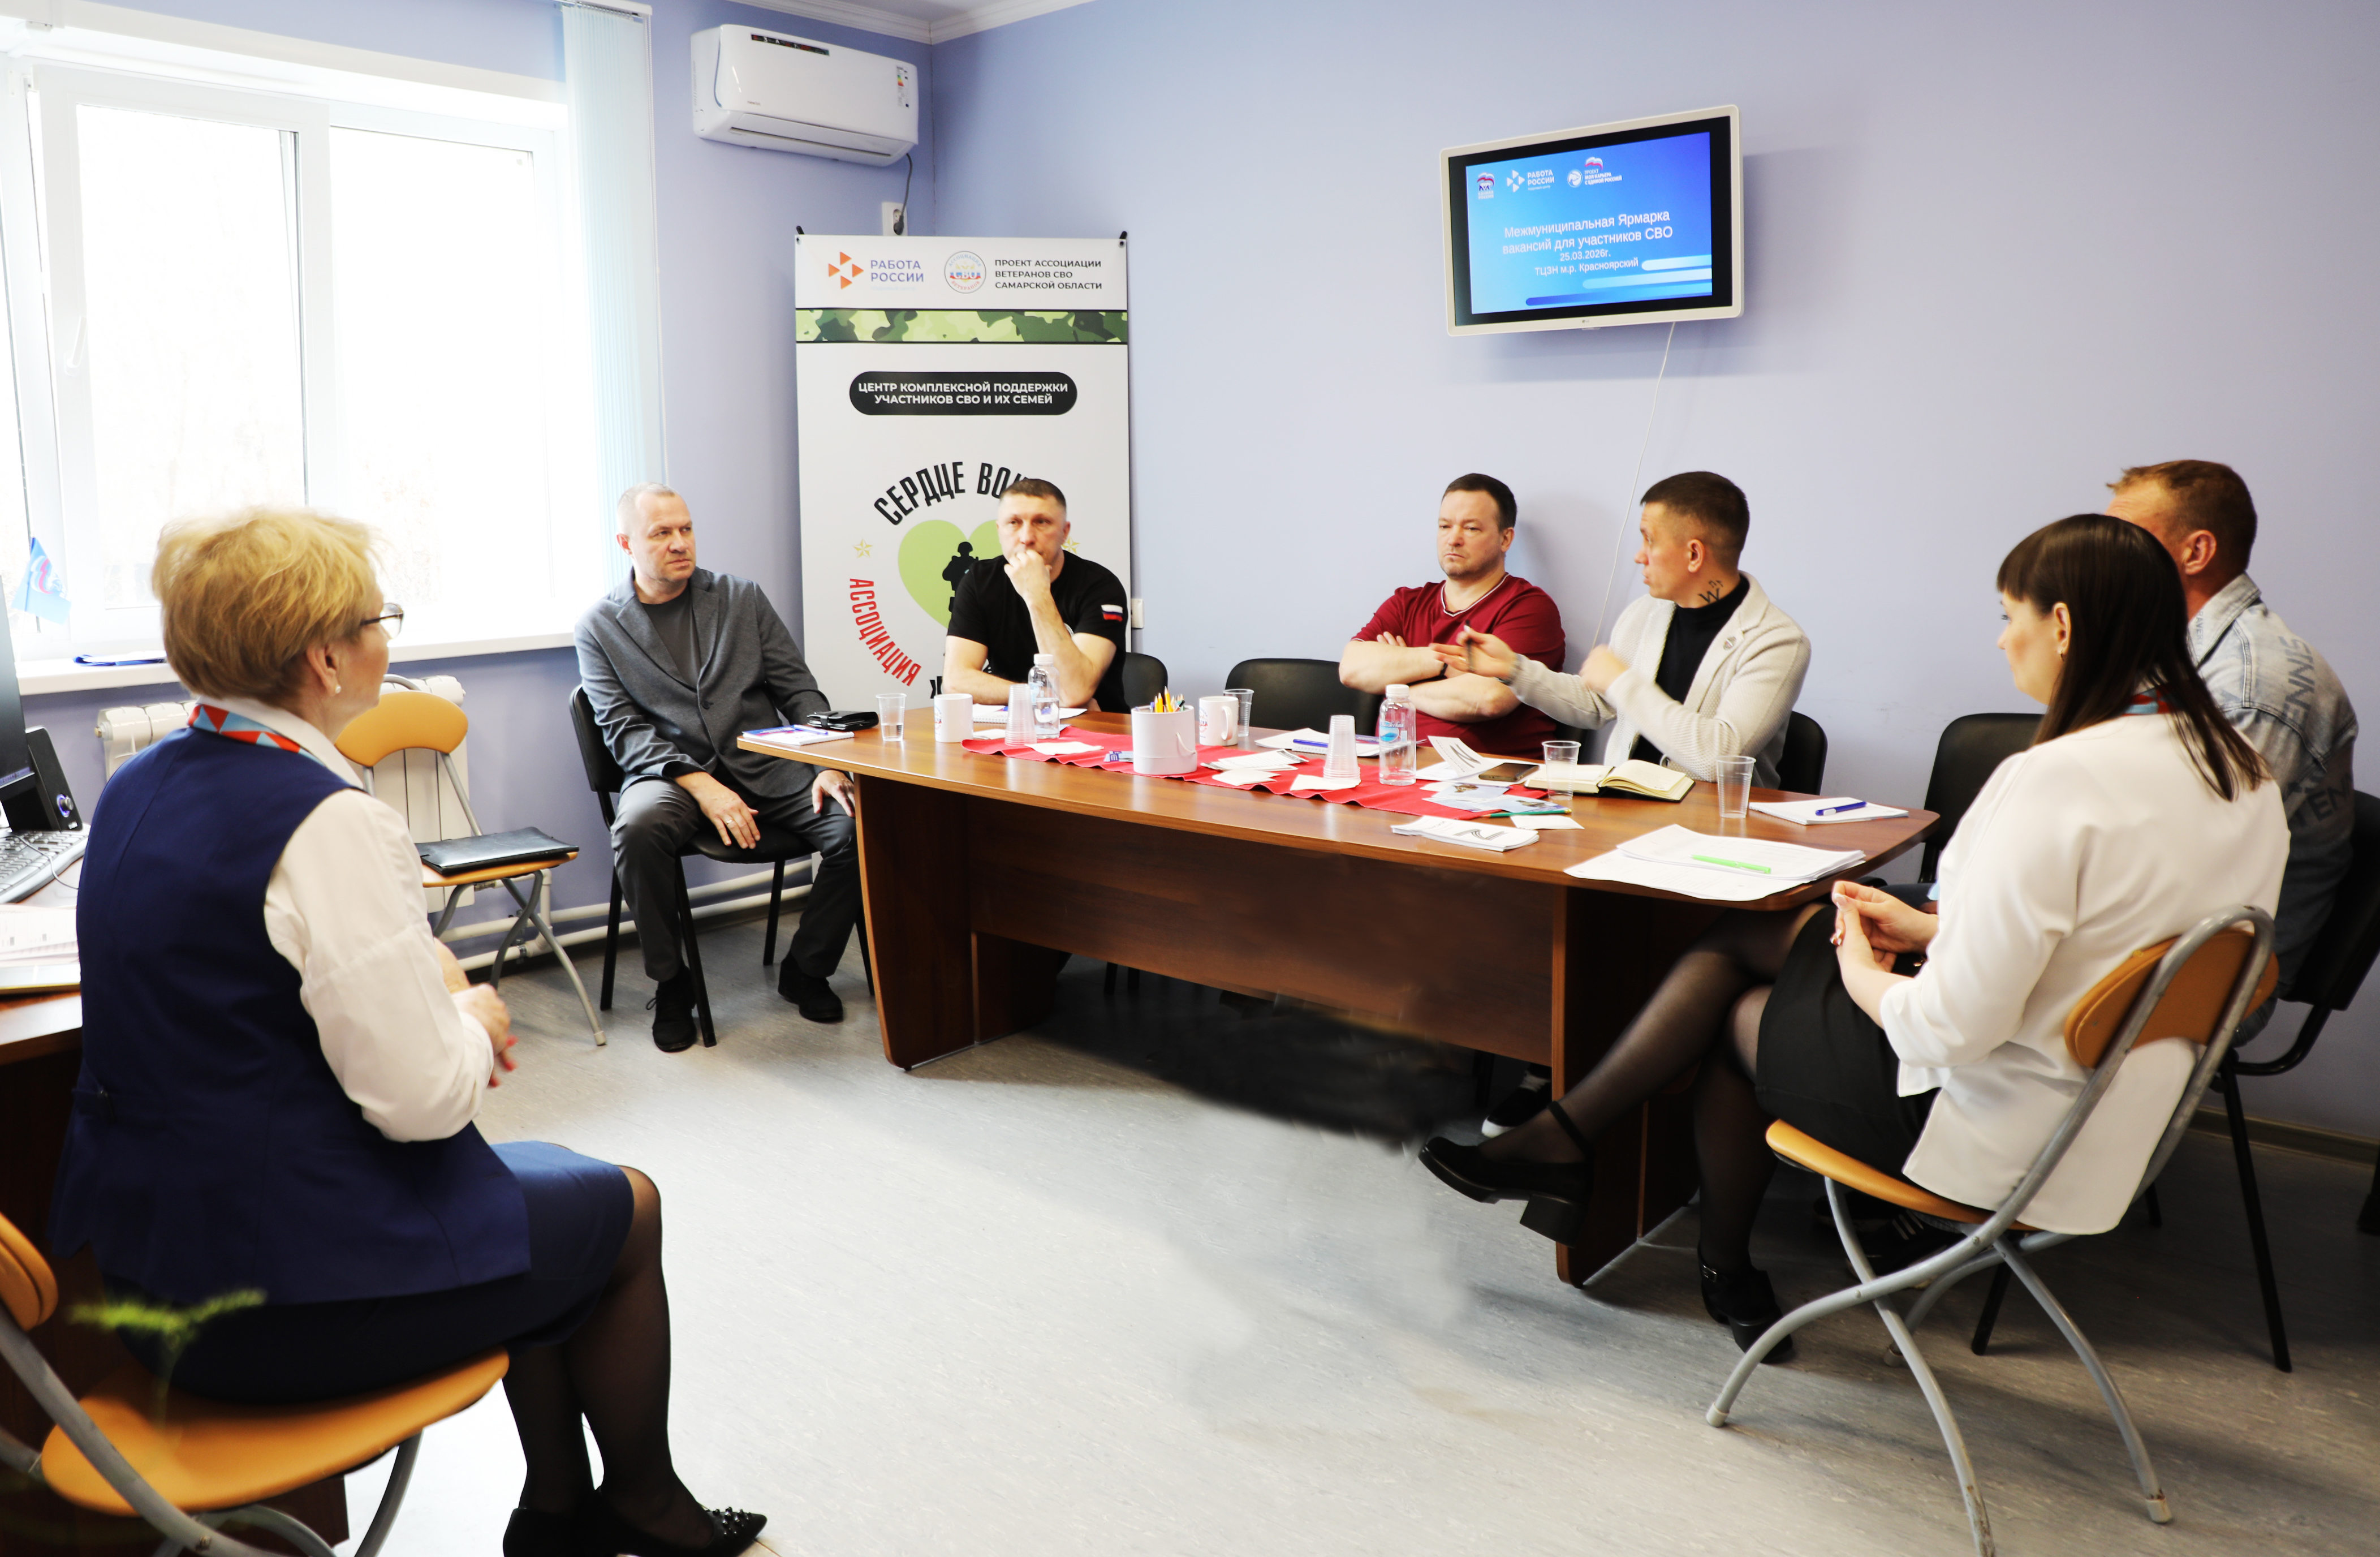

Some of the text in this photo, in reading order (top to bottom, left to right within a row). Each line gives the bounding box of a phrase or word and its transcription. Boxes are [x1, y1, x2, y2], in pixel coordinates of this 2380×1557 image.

[1528, 169, 1553, 179] РАБОТА
[1528, 177, 1555, 186] РОССИИ
[1504, 211, 1670, 238] Межмуниципальная Ярмарка
[1503, 226, 1673, 254] вакансий для участников СВО
[1560, 249, 1611, 261] 25.03.2026г.
[870, 260, 921, 269] РАБОТА
[1535, 257, 1639, 277] ТЦЗН м.р. Красноярский
[871, 272, 924, 282] РОССИИ
[995, 281, 1055, 289] САМАРСКОЙ
[859, 382, 1068, 394] ЦЕНТР КОМПЛЕКСНОЙ ПОДДЕРЖКИ
[875, 393, 1053, 404] УЧАСТНИКОВ СВО И ИХ СЕМЕЙ
[874, 462, 1028, 526] СЕРДЦЕ ВО
[850, 578, 922, 686] АССОЦИАЦИЯ
